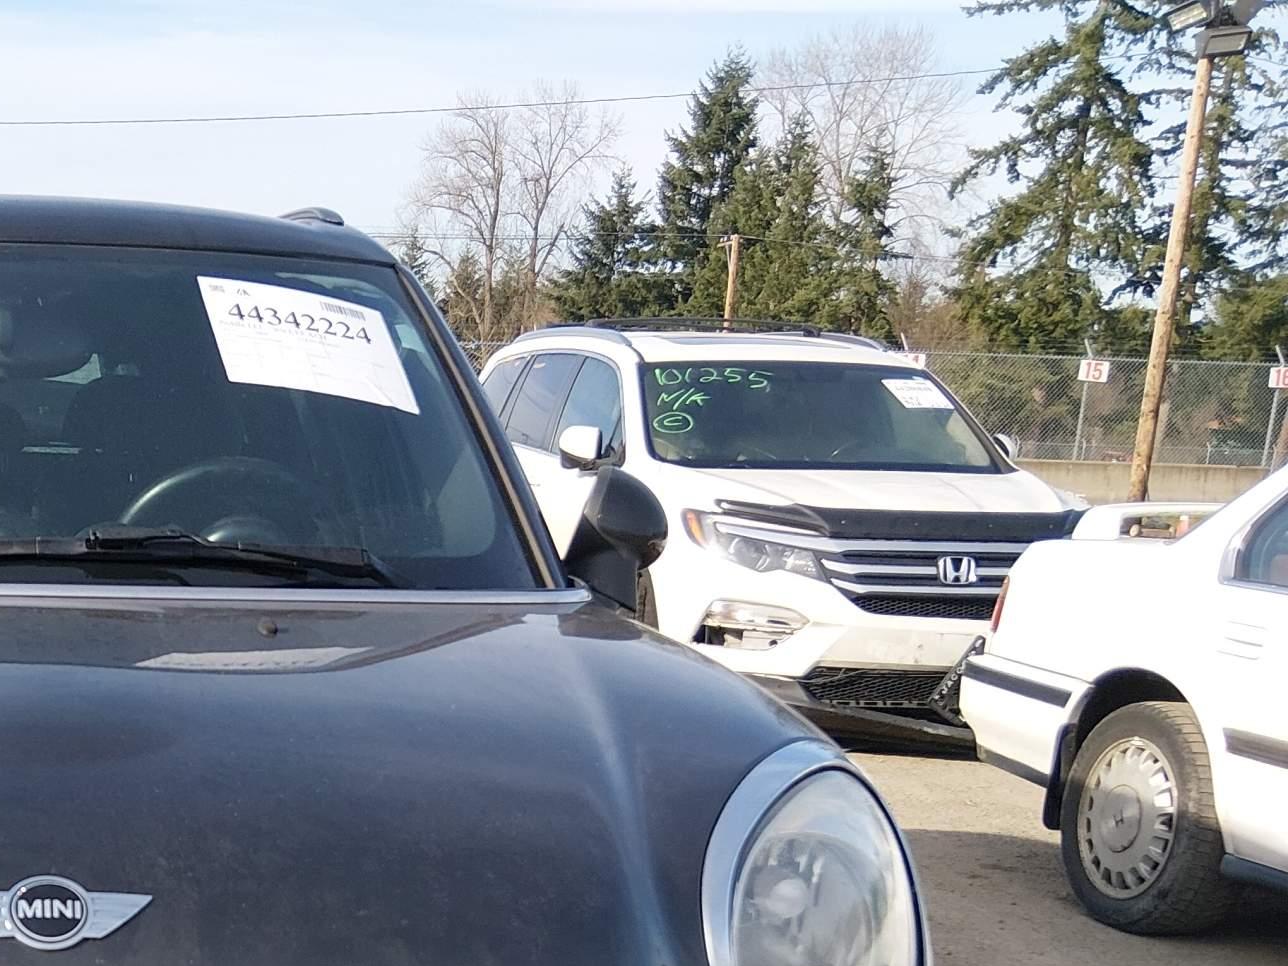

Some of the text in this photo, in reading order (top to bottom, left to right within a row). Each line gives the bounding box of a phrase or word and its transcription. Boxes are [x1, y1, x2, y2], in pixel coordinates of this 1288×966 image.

[228, 303, 372, 344] 44342224
[1085, 361, 1104, 380] 15
[17, 898, 81, 919] MINI
